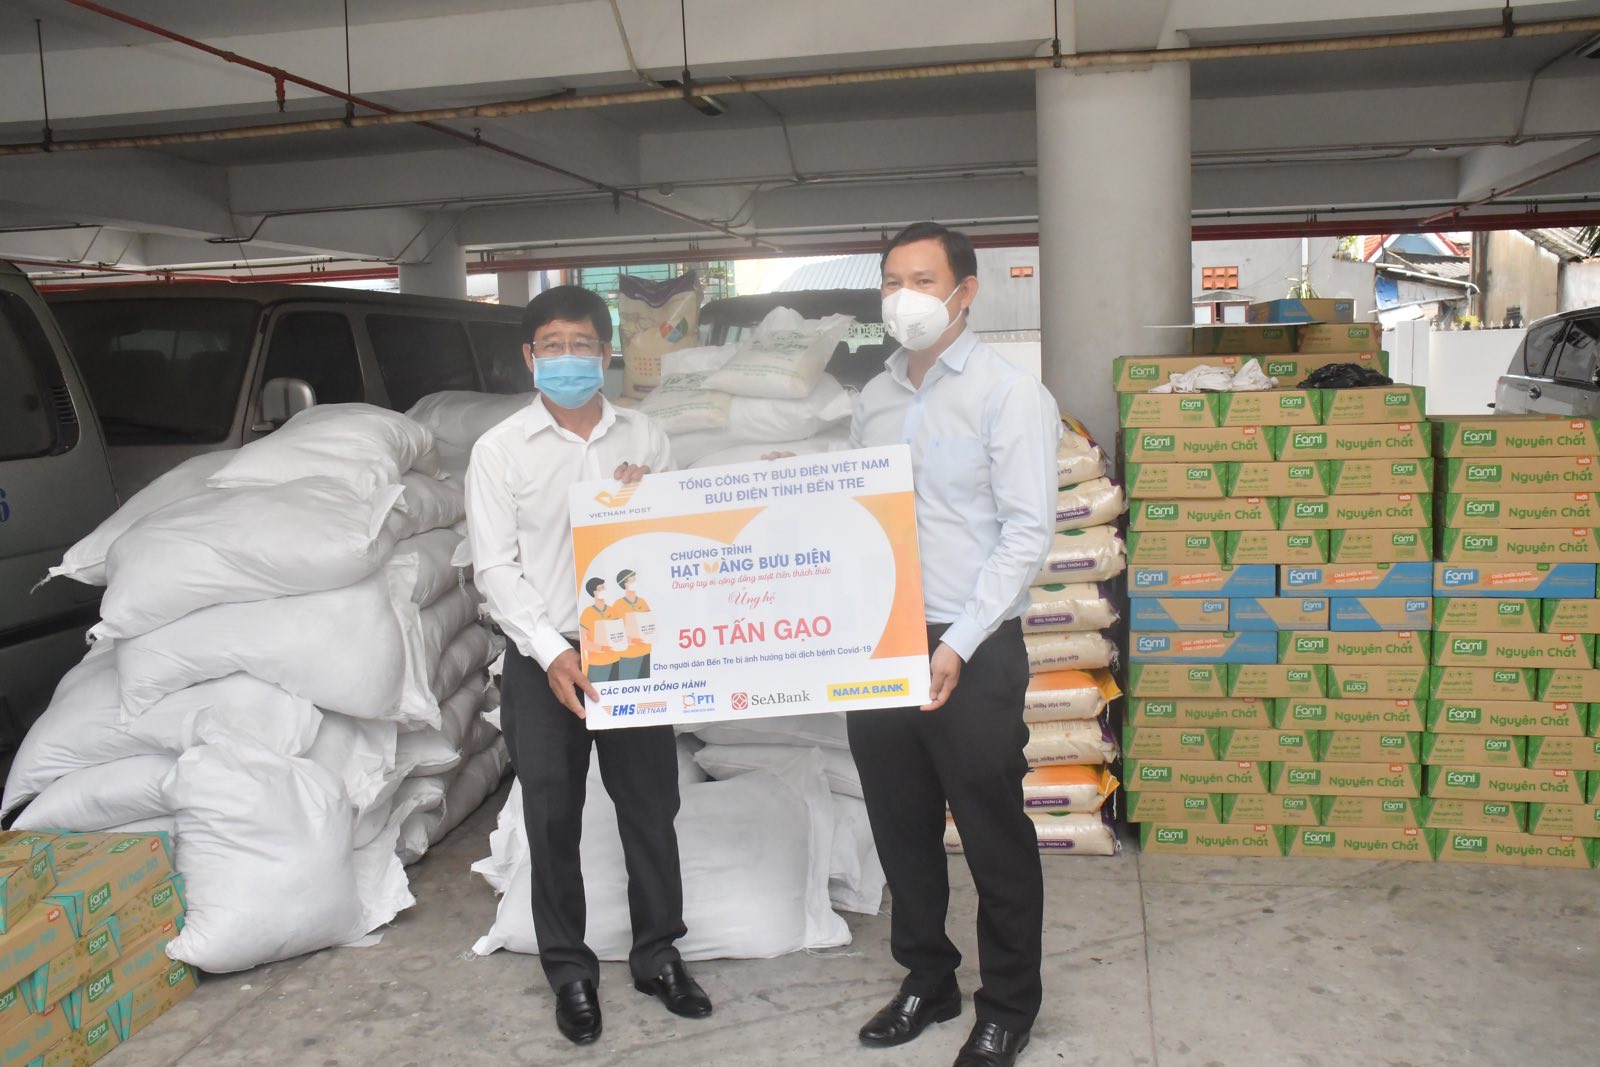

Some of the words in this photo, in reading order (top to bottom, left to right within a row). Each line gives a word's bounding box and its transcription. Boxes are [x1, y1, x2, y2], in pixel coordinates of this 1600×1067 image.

[1184, 440, 1229, 454] Nguyên
[1231, 436, 1259, 451] Chất
[1335, 438, 1382, 451] Nguyên
[1385, 433, 1414, 448] Chất
[1505, 435, 1553, 448] Nguyên
[1557, 431, 1586, 446] Chất
[679, 475, 712, 491] TỔNG
[715, 473, 750, 488] CÔNG
[753, 471, 768, 483] TY
[771, 467, 797, 481] BƯU
[799, 464, 829, 479] ĐIỆN
[832, 460, 858, 475] VIỆT
[861, 458, 890, 471] NAM
[1511, 471, 1559, 484] Nguyên
[1563, 467, 1593, 481] Chất
[705, 491, 733, 505] BƯU
[736, 486, 768, 502] ĐIỆN
[806, 476, 835, 494] BẾN
[838, 477, 865, 489] TRE
[589, 510, 626, 519] VIETNAM
[628, 507, 652, 515] POST
[1187, 510, 1233, 523] Nguyên
[1235, 506, 1261, 520] Chất
[1337, 507, 1382, 521] Nguyên
[1385, 503, 1413, 517] Chất
[1508, 507, 1557, 520] Nguyên
[1560, 503, 1591, 517] Chất
[670, 548, 718, 561] CHƯƠNG
[721, 544, 752, 556] TRÌNH
[1506, 542, 1555, 554] Nguyên
[1559, 538, 1589, 552] Chất
[671, 563, 700, 580] HẠT
[759, 553, 789, 570] BƯU
[794, 548, 831, 568] ĐIỆN
[678, 627, 706, 649] 50
[713, 616, 765, 646] TẤN
[774, 615, 832, 642] GẠO
[1338, 644, 1382, 657] Nguyên
[1385, 640, 1413, 655] Chất
[1496, 646, 1543, 659] Nguyên
[1547, 643, 1577, 657] Chất
[653, 663, 668, 671] Cho
[669, 661, 690, 671] người
[691, 659, 705, 668] dân
[722, 657, 734, 665] Tre
[798, 649, 815, 659] dịch
[816, 648, 836, 657] bệnh
[837, 645, 872, 655] Covid-19
[600, 686, 619, 696] CÁC
[621, 685, 641, 694] ĐƠN
[643, 684, 651, 694] VỊ
[653, 680, 679, 691] ĐỒNG
[681, 679, 707, 689] HÀNH
[833, 686, 860, 697] NAM
[862, 685, 870, 695] A
[871, 683, 904, 694] BANK
[697, 694, 715, 705] PTI
[751, 690, 811, 706] SeABank
[612, 704, 636, 717] EMS
[636, 706, 667, 715] VIETNAM
[1184, 709, 1228, 721] Nguyên
[1231, 705, 1257, 718] Chất
[1334, 711, 1380, 725] Nguyên
[1384, 708, 1411, 722] Chất
[1489, 715, 1537, 728] Nguyên
[1541, 713, 1570, 726] Chất
[1180, 773, 1224, 785] Nguyên
[1227, 771, 1253, 784] Chất
[1328, 776, 1374, 789] Nguyên
[1377, 774, 1405, 788] Chất
[1488, 780, 1536, 793] Nguyên
[1540, 778, 1569, 792] Chất
[1196, 835, 1240, 848] Nguyên
[1242, 833, 1269, 847] Chất
[1343, 840, 1389, 852] Nguyên
[1391, 837, 1419, 852] Chất
[1495, 844, 1542, 857] Nguyên
[1547, 842, 1577, 858] Chất
